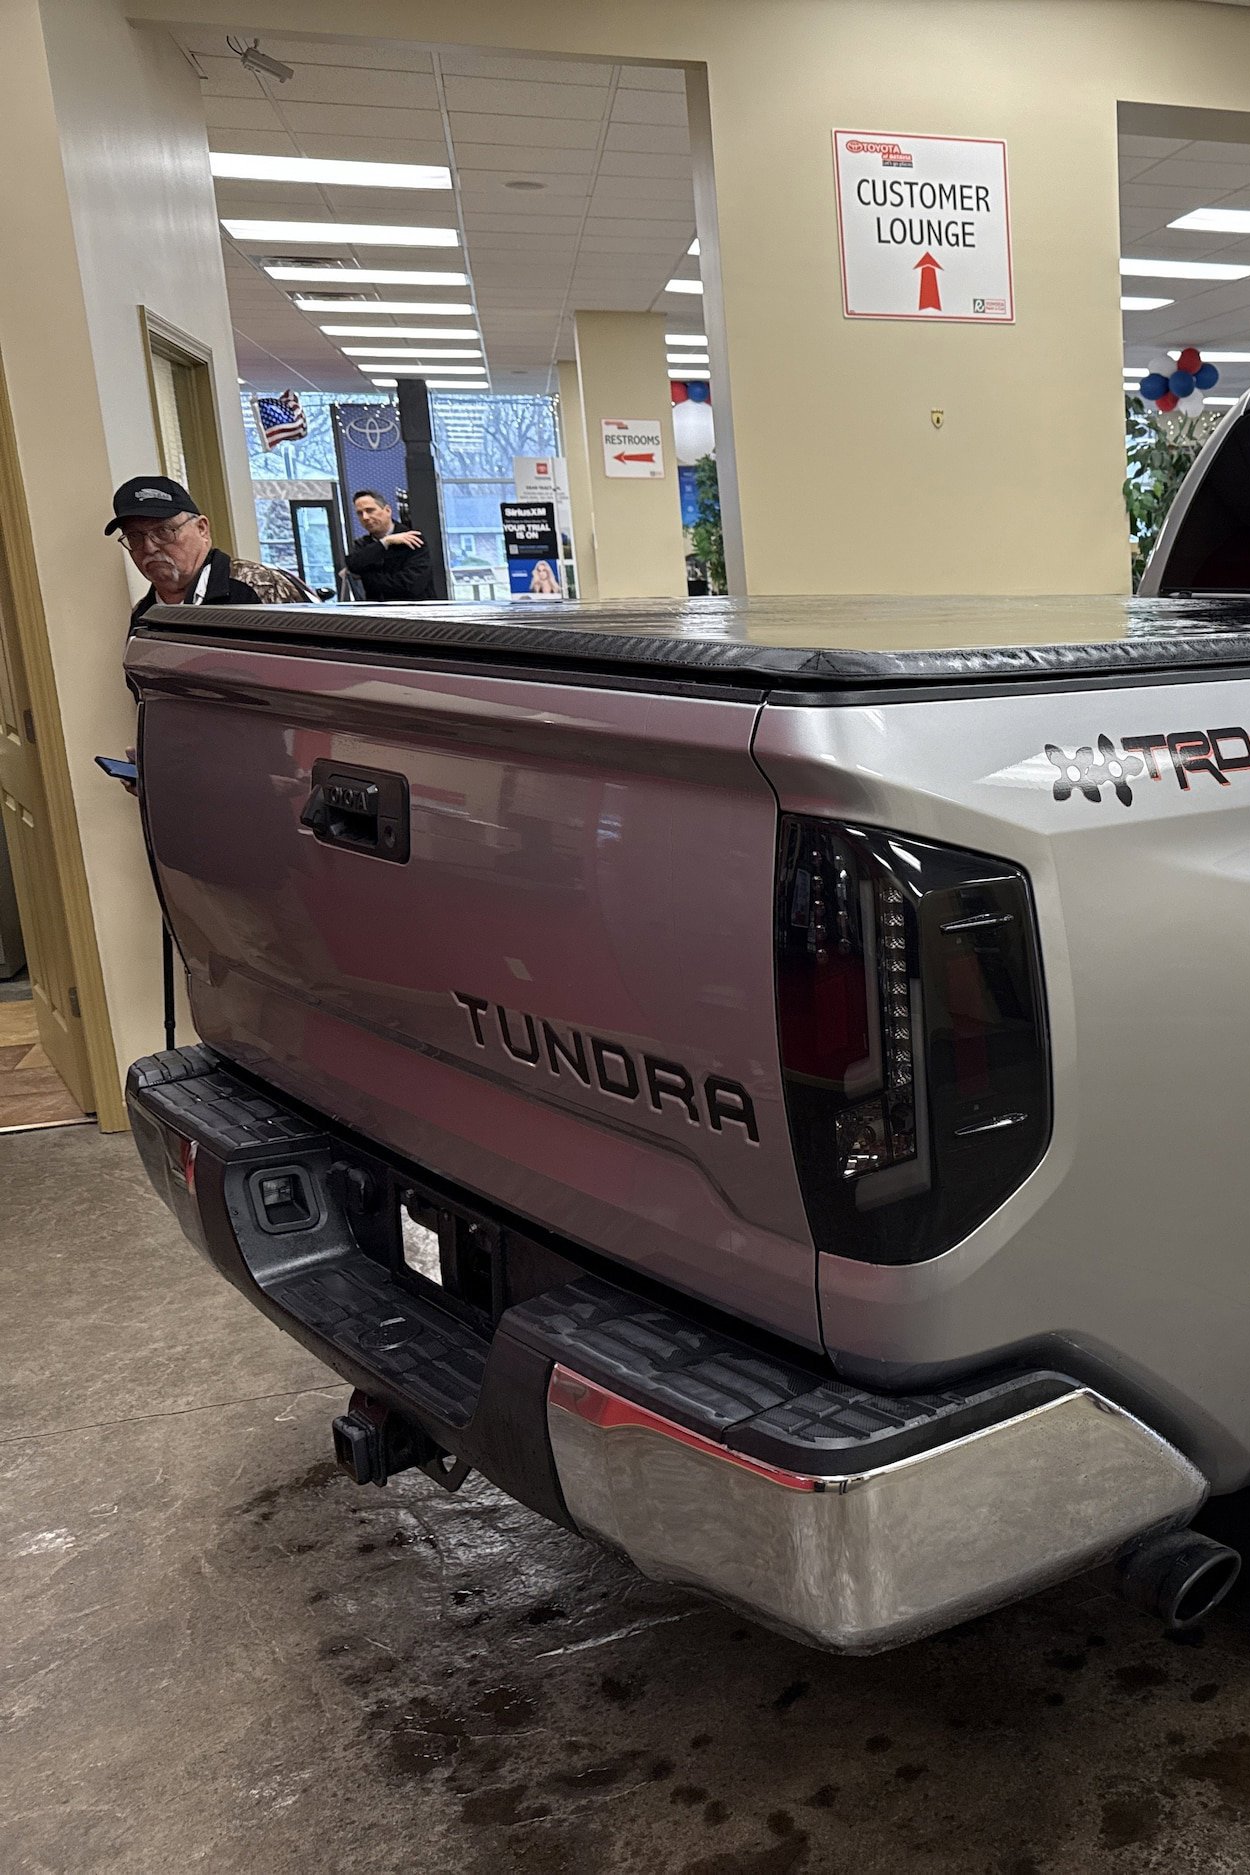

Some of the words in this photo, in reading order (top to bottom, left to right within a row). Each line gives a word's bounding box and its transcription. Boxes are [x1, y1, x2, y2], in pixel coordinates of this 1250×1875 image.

[863, 143, 901, 154] TOYOTA
[857, 178, 991, 212] CUSTOMER
[876, 217, 976, 248] LOUNGE
[604, 434, 661, 446] RESTROOMS
[504, 507, 547, 517] SiriusXM
[503, 523, 526, 532] YOUR
[527, 523, 551, 532] TRIAL
[516, 531, 525, 540] IS
[526, 531, 539, 540] ON
[451, 990, 760, 1148] TUNDRA
